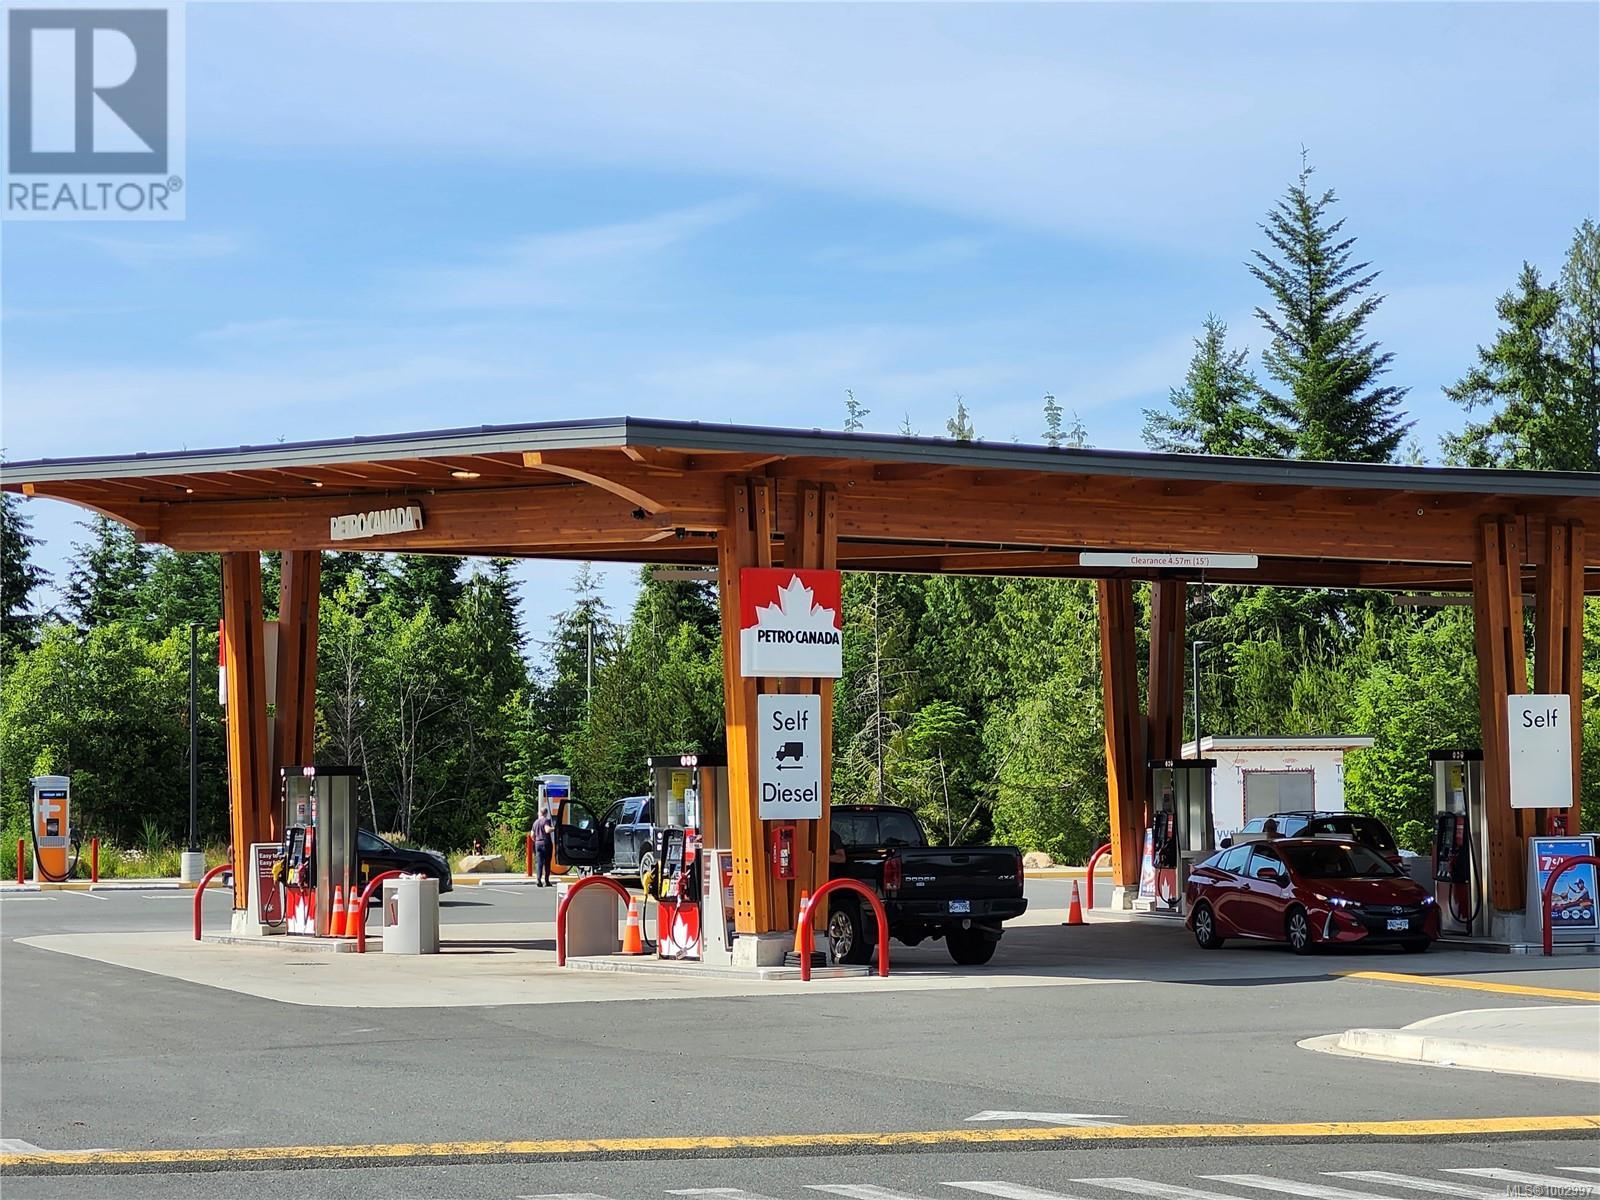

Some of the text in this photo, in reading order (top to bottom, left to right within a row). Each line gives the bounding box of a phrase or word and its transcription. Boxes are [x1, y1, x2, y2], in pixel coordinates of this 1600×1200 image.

[1130, 556, 1210, 567] Clearance 4.57m (15')
[772, 710, 809, 731] Self
[1522, 708, 1558, 728] Self
[762, 781, 818, 802] Diesel
